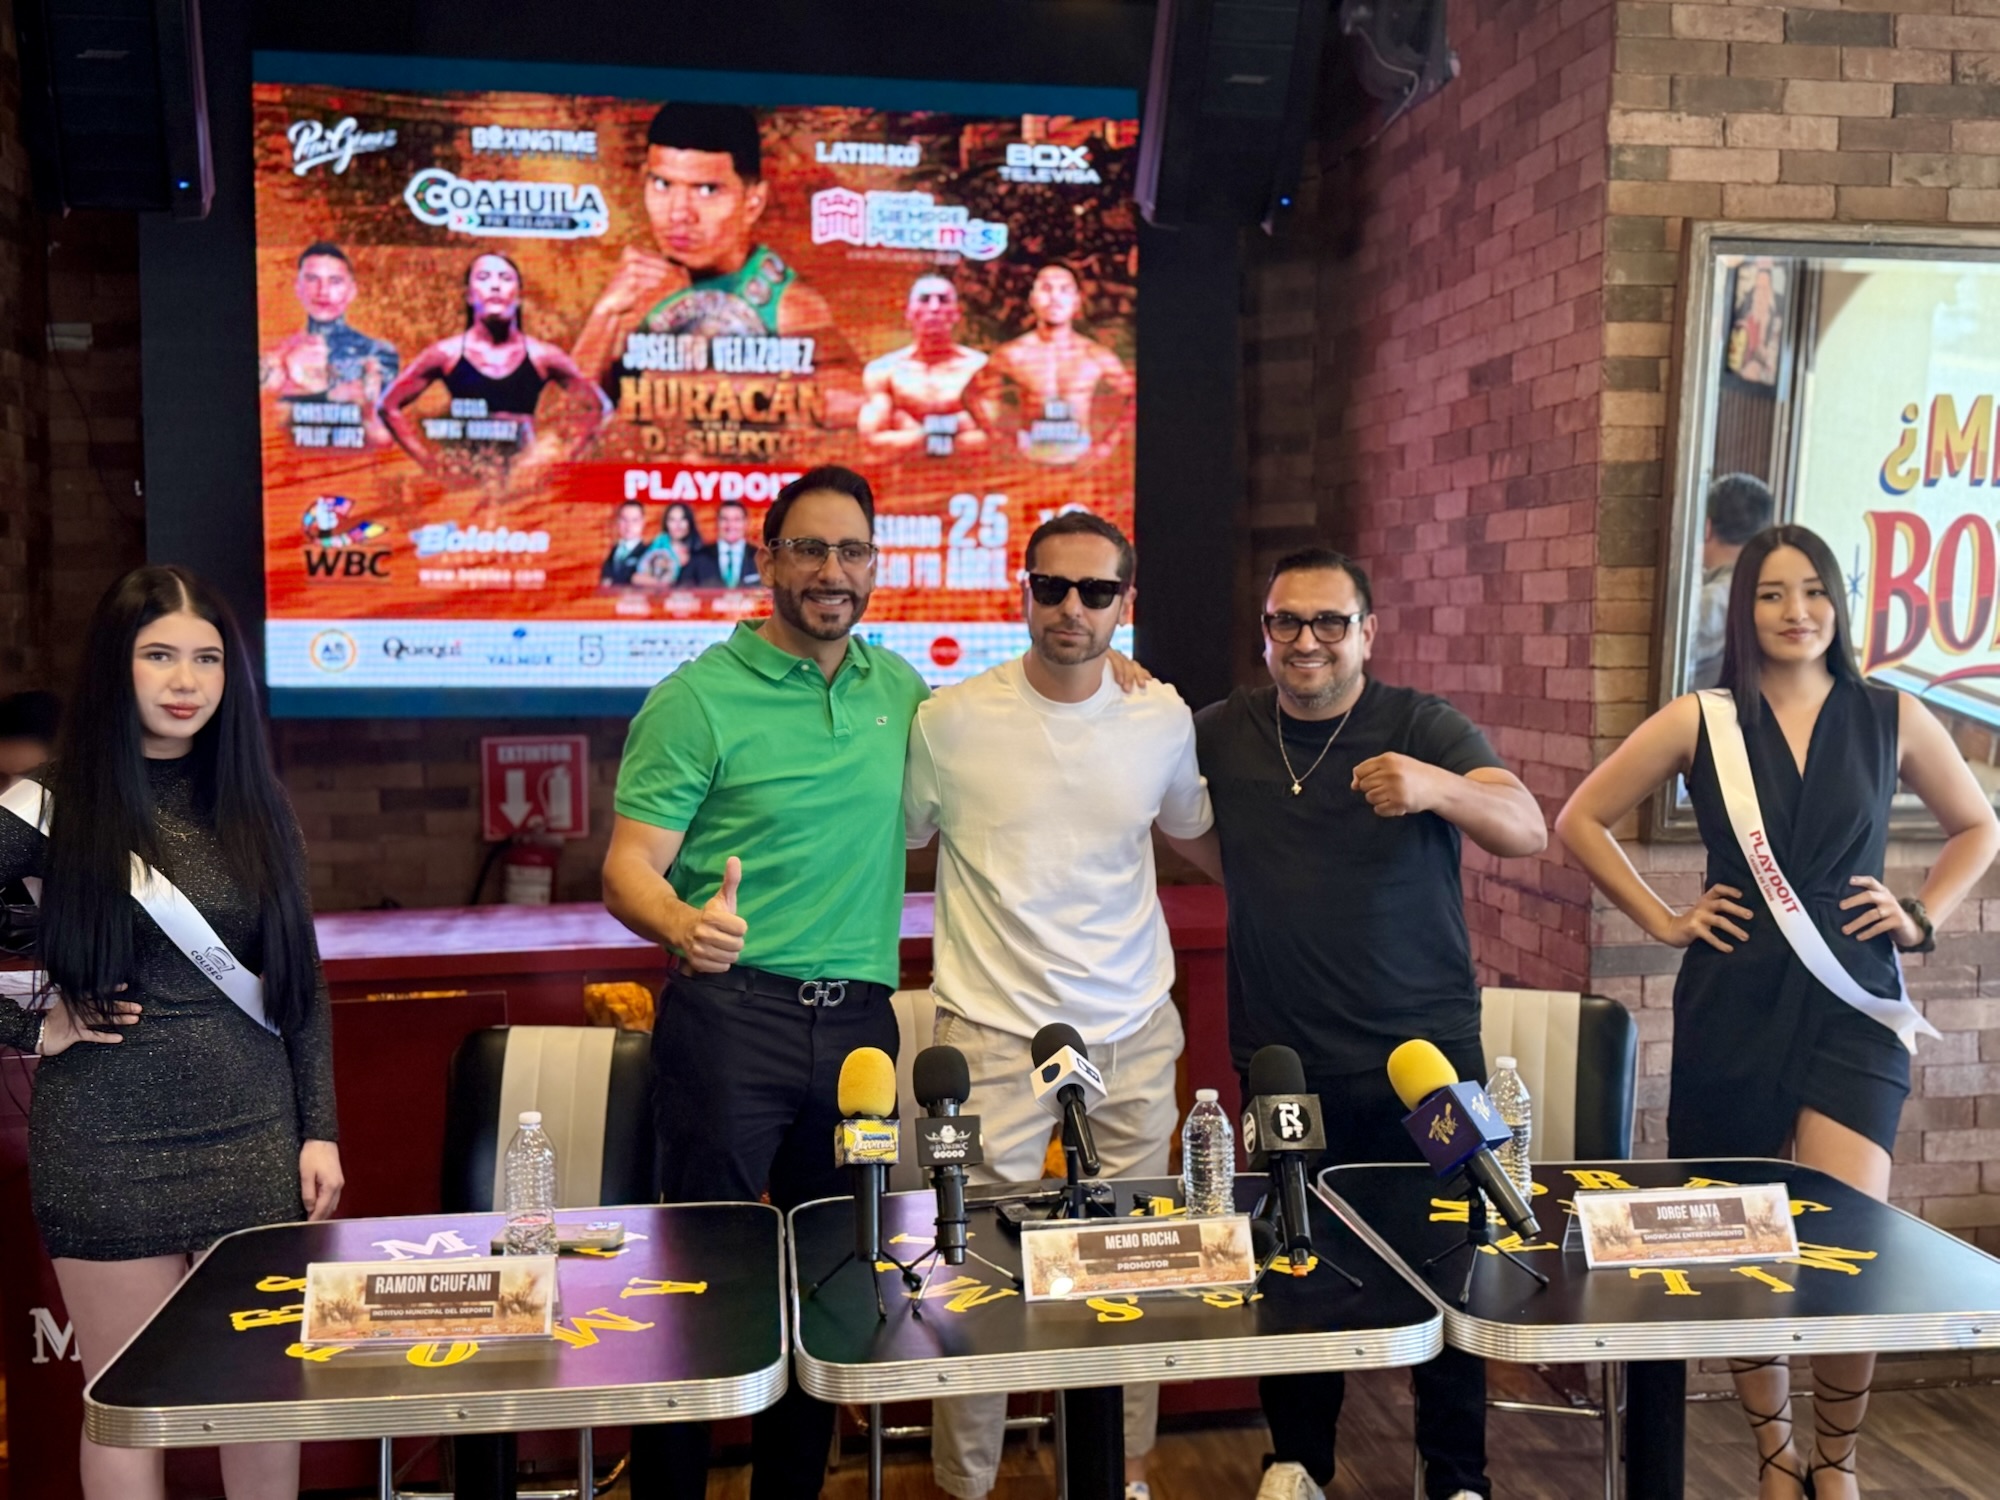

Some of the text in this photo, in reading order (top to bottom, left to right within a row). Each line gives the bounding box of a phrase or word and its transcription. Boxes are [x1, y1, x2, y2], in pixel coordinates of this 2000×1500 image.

[1006, 143, 1089, 169] BOX
[998, 165, 1101, 183] TELEVISA
[412, 177, 601, 216] COAHUILA
[1879, 393, 2000, 496] ¿M
[948, 493, 1008, 548] 25
[304, 551, 391, 577] WBC
[1860, 510, 2000, 679] BO
[1749, 829, 1800, 913] PLAYDOIT
[191, 950, 223, 981] COLISEO
[1657, 1203, 1720, 1220] JORGE MATA
[1105, 1231, 1180, 1249] MEMO ROCHA
[1643, 1232, 1681, 1241] SHOWCASE
[1117, 1259, 1169, 1271] PROMOTOR
[375, 1273, 492, 1294] RAMON CHUFANI
[405, 1308, 443, 1316] MUNICIPAL
[445, 1307, 459, 1315] DEL
[460, 1306, 492, 1315] DEPORTE
